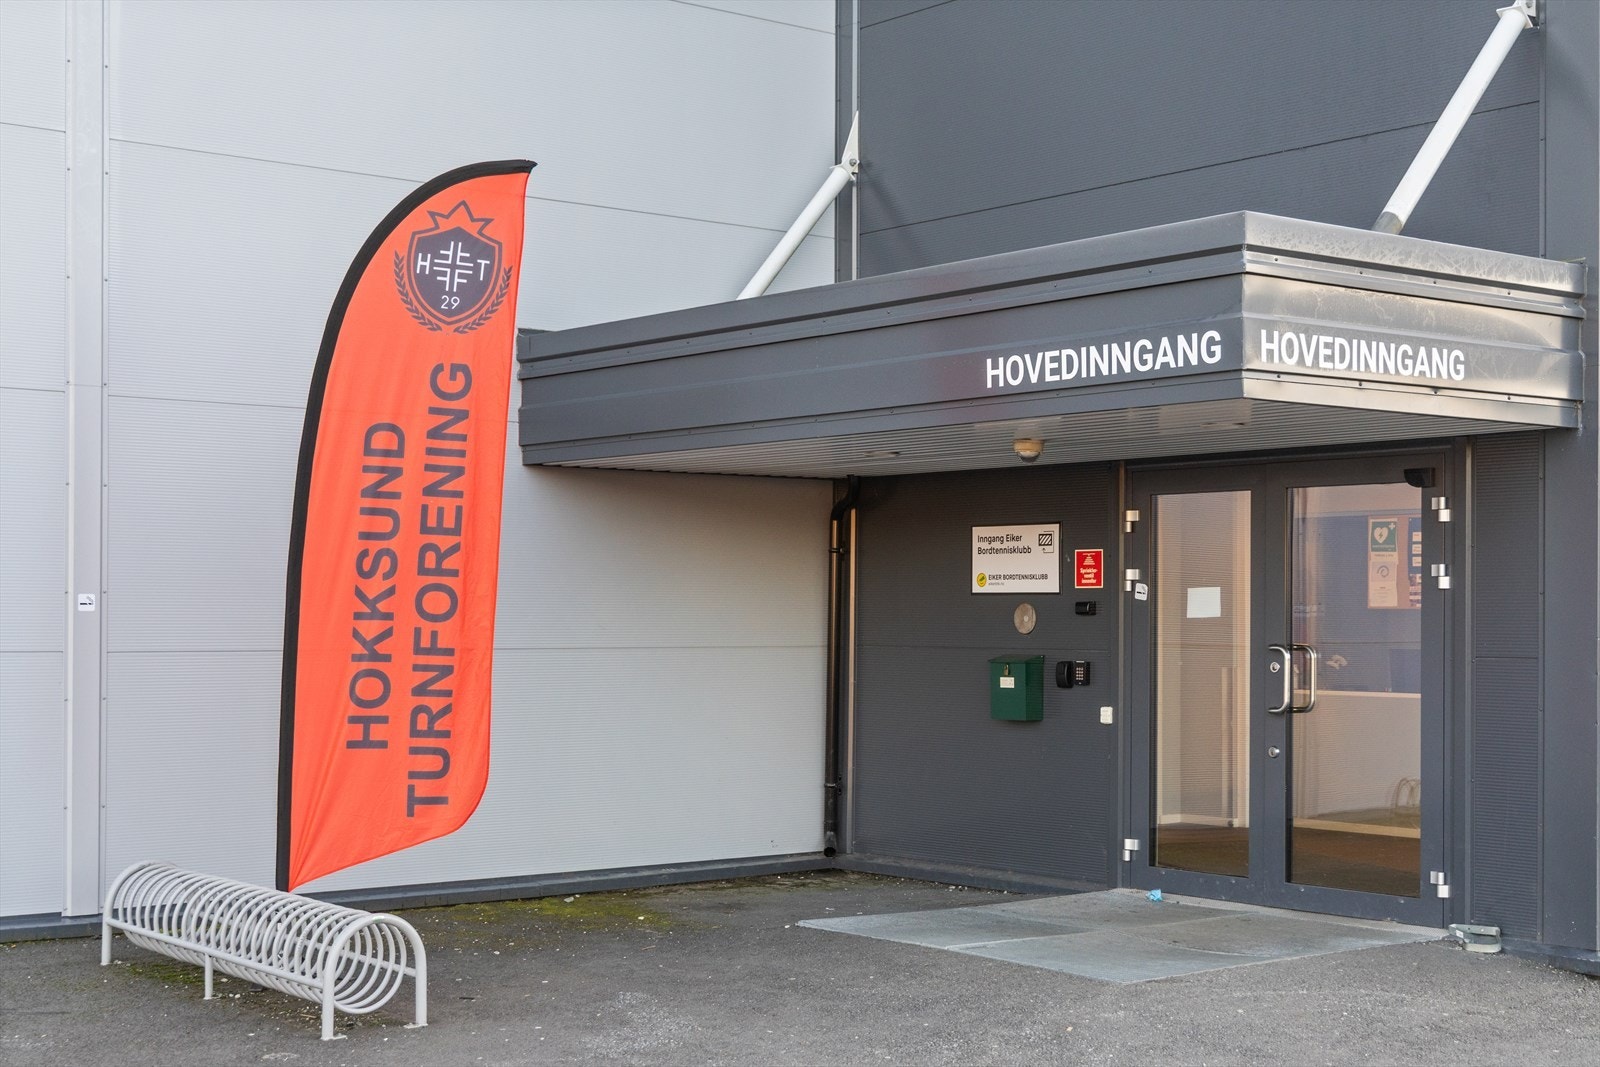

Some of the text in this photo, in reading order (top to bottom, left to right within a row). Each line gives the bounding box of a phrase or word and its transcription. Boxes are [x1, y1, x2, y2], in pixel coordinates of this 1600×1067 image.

[440, 295, 461, 310] 29
[986, 330, 1223, 389] HOVEDINNGANG
[1260, 329, 1466, 381] HOVEDINNGANG
[977, 533, 1022, 545] Inngang Eiker
[977, 545, 1032, 555] Bordtennisklubb
[346, 420, 406, 750] HOKKSUND
[406, 361, 473, 817] TURNFORENING
[988, 573, 1048, 581] EIKER BORDTENNISKLUBB
